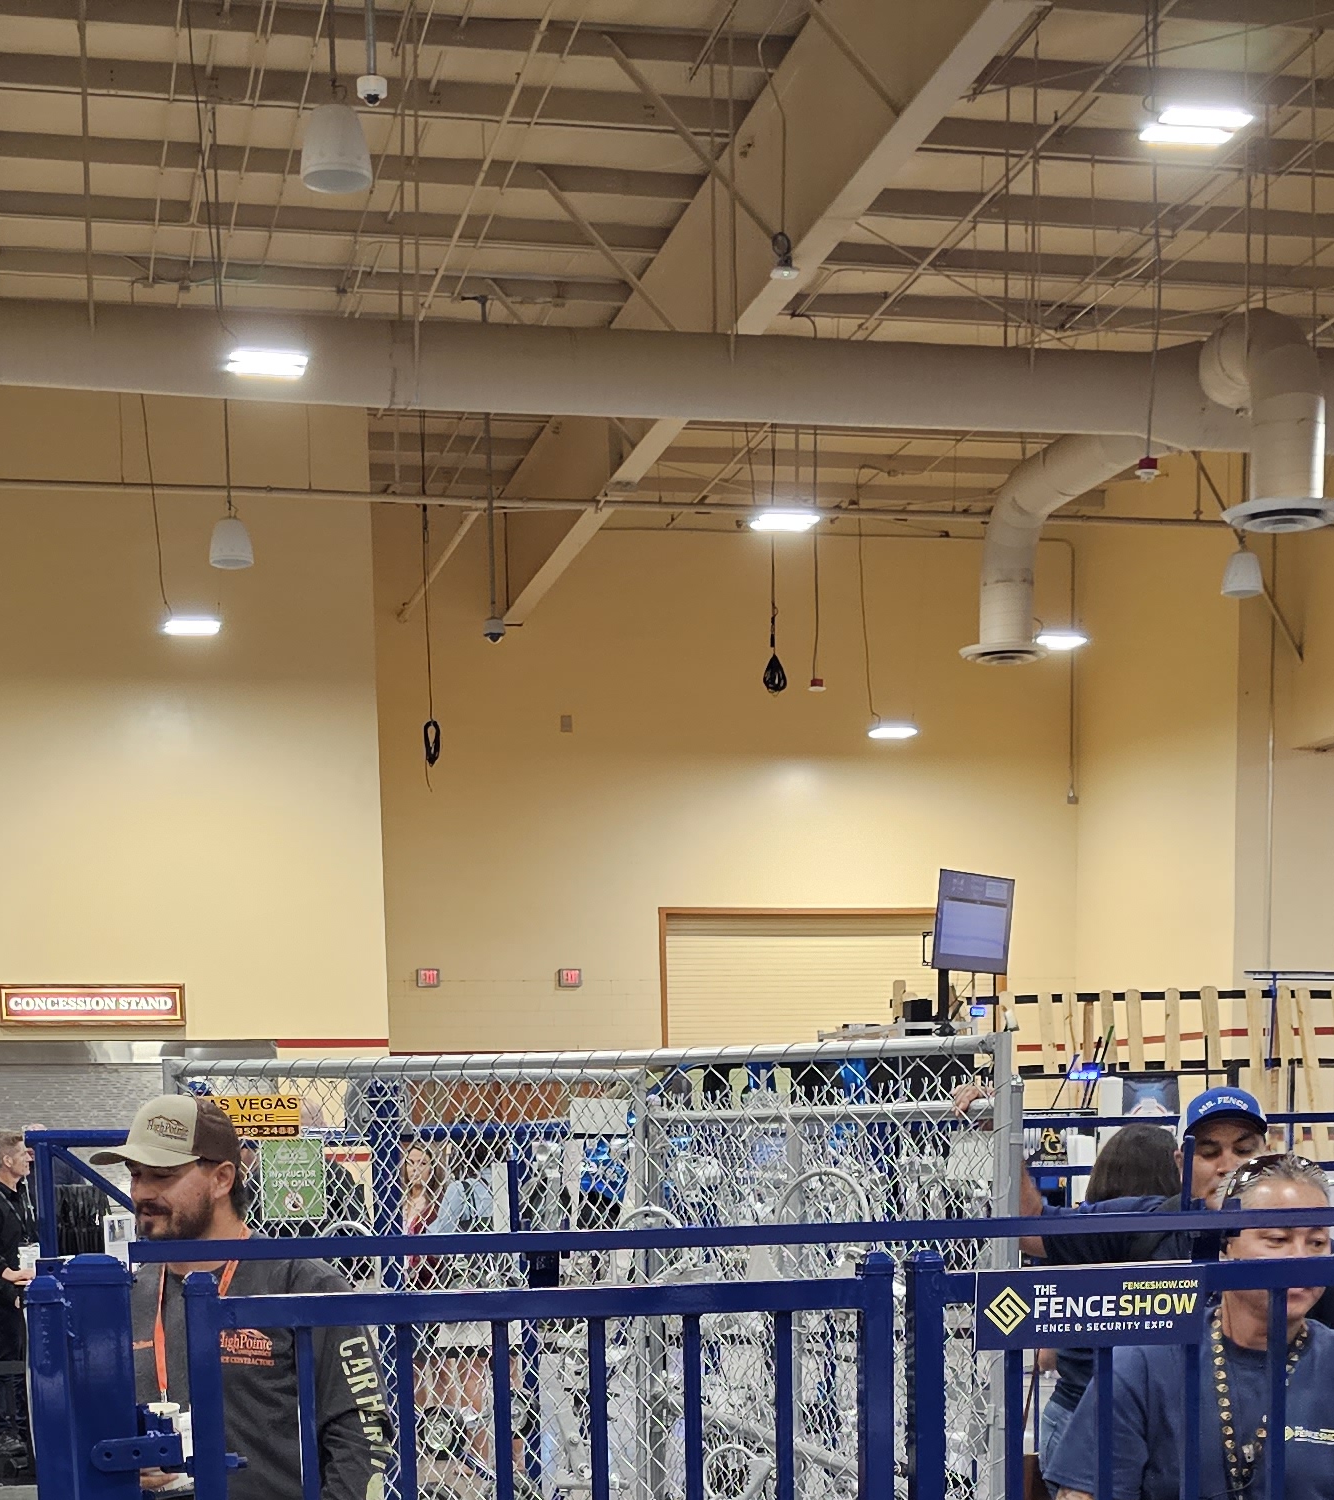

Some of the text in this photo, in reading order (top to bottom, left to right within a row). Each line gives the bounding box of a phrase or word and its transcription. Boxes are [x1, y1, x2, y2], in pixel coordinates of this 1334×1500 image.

[9, 996, 173, 1011] CONCESSION STAND
[236, 1097, 298, 1111] VEGAS
[1198, 1100, 1216, 1116] MR.
[229, 1113, 275, 1123] ENCE
[1033, 1284, 1057, 1296] THE
[1122, 1280, 1199, 1291] FENCESHOW.COM
[1035, 1323, 1071, 1333] FENCE
[1086, 1321, 1141, 1332] SECURITY
[1144, 1320, 1174, 1330] EXPO
